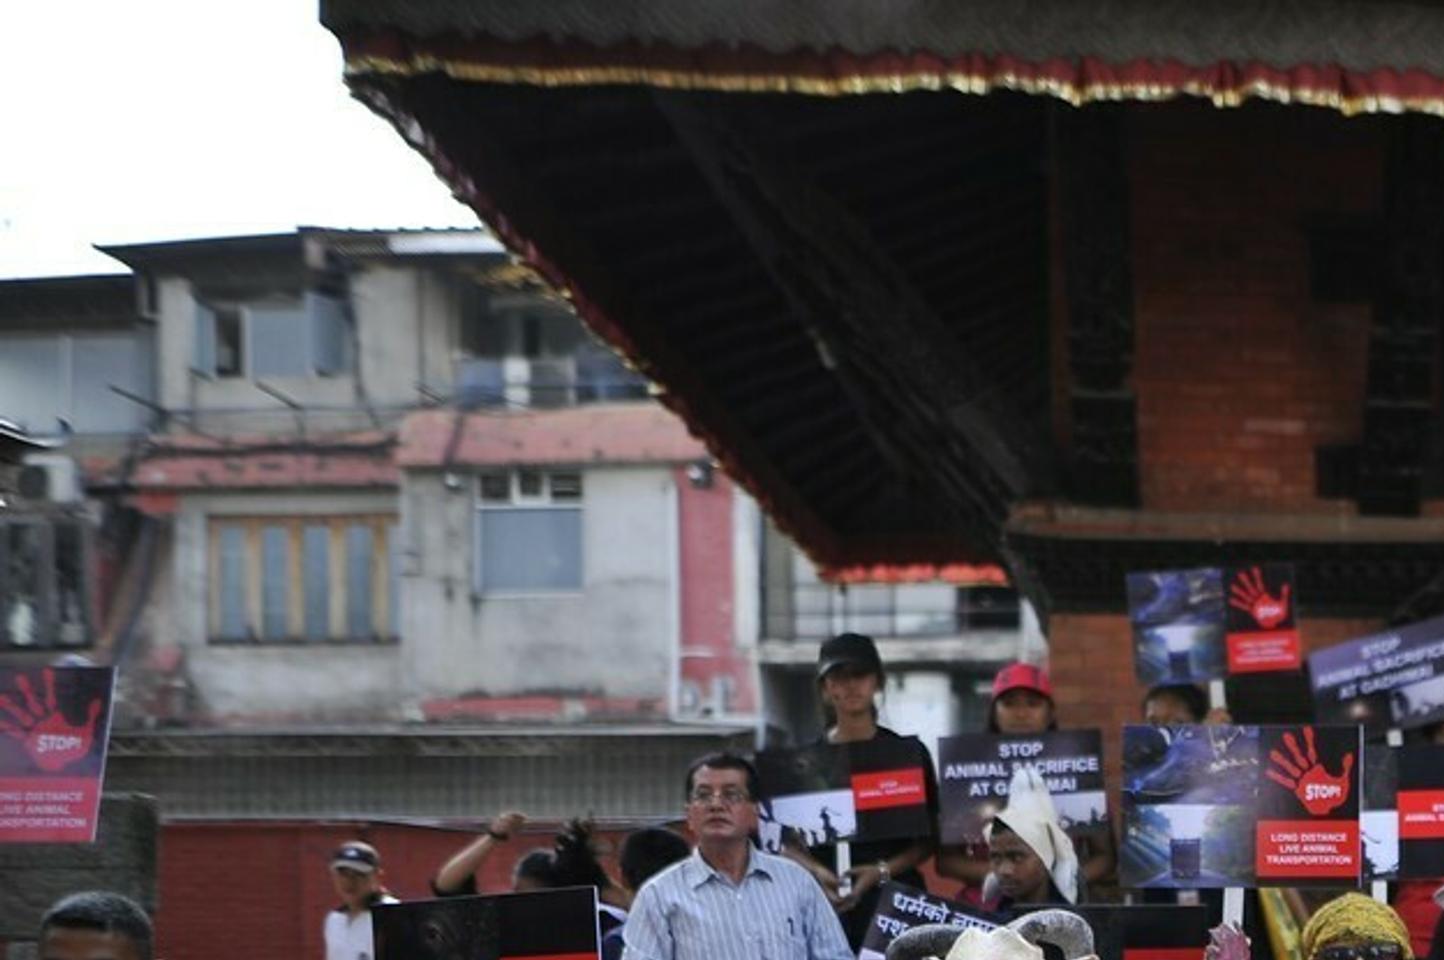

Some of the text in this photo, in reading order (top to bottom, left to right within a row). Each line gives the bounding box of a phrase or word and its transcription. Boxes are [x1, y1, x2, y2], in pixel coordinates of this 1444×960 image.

[1361, 636, 1401, 660] STOP
[1316, 663, 1370, 688] ANIMAL
[37, 734, 82, 753] STOP!
[998, 740, 1044, 758] STOP
[945, 762, 1009, 779] ANIMAL
[970, 777, 1077, 797] AT GMAI
[1304, 783, 1342, 800] STOP!
[0, 791, 83, 803] ONG DISTANCE
[0, 804, 71, 815] IVE ANIMAL
[0, 817, 87, 829] NSPORTATION
[1270, 832, 1347, 843] LONG DISTANCE
[1279, 844, 1338, 854] LIVE ANIMAL
[1265, 855, 1353, 866] TRANSPORTATION
[893, 892, 951, 924] धर्मको
